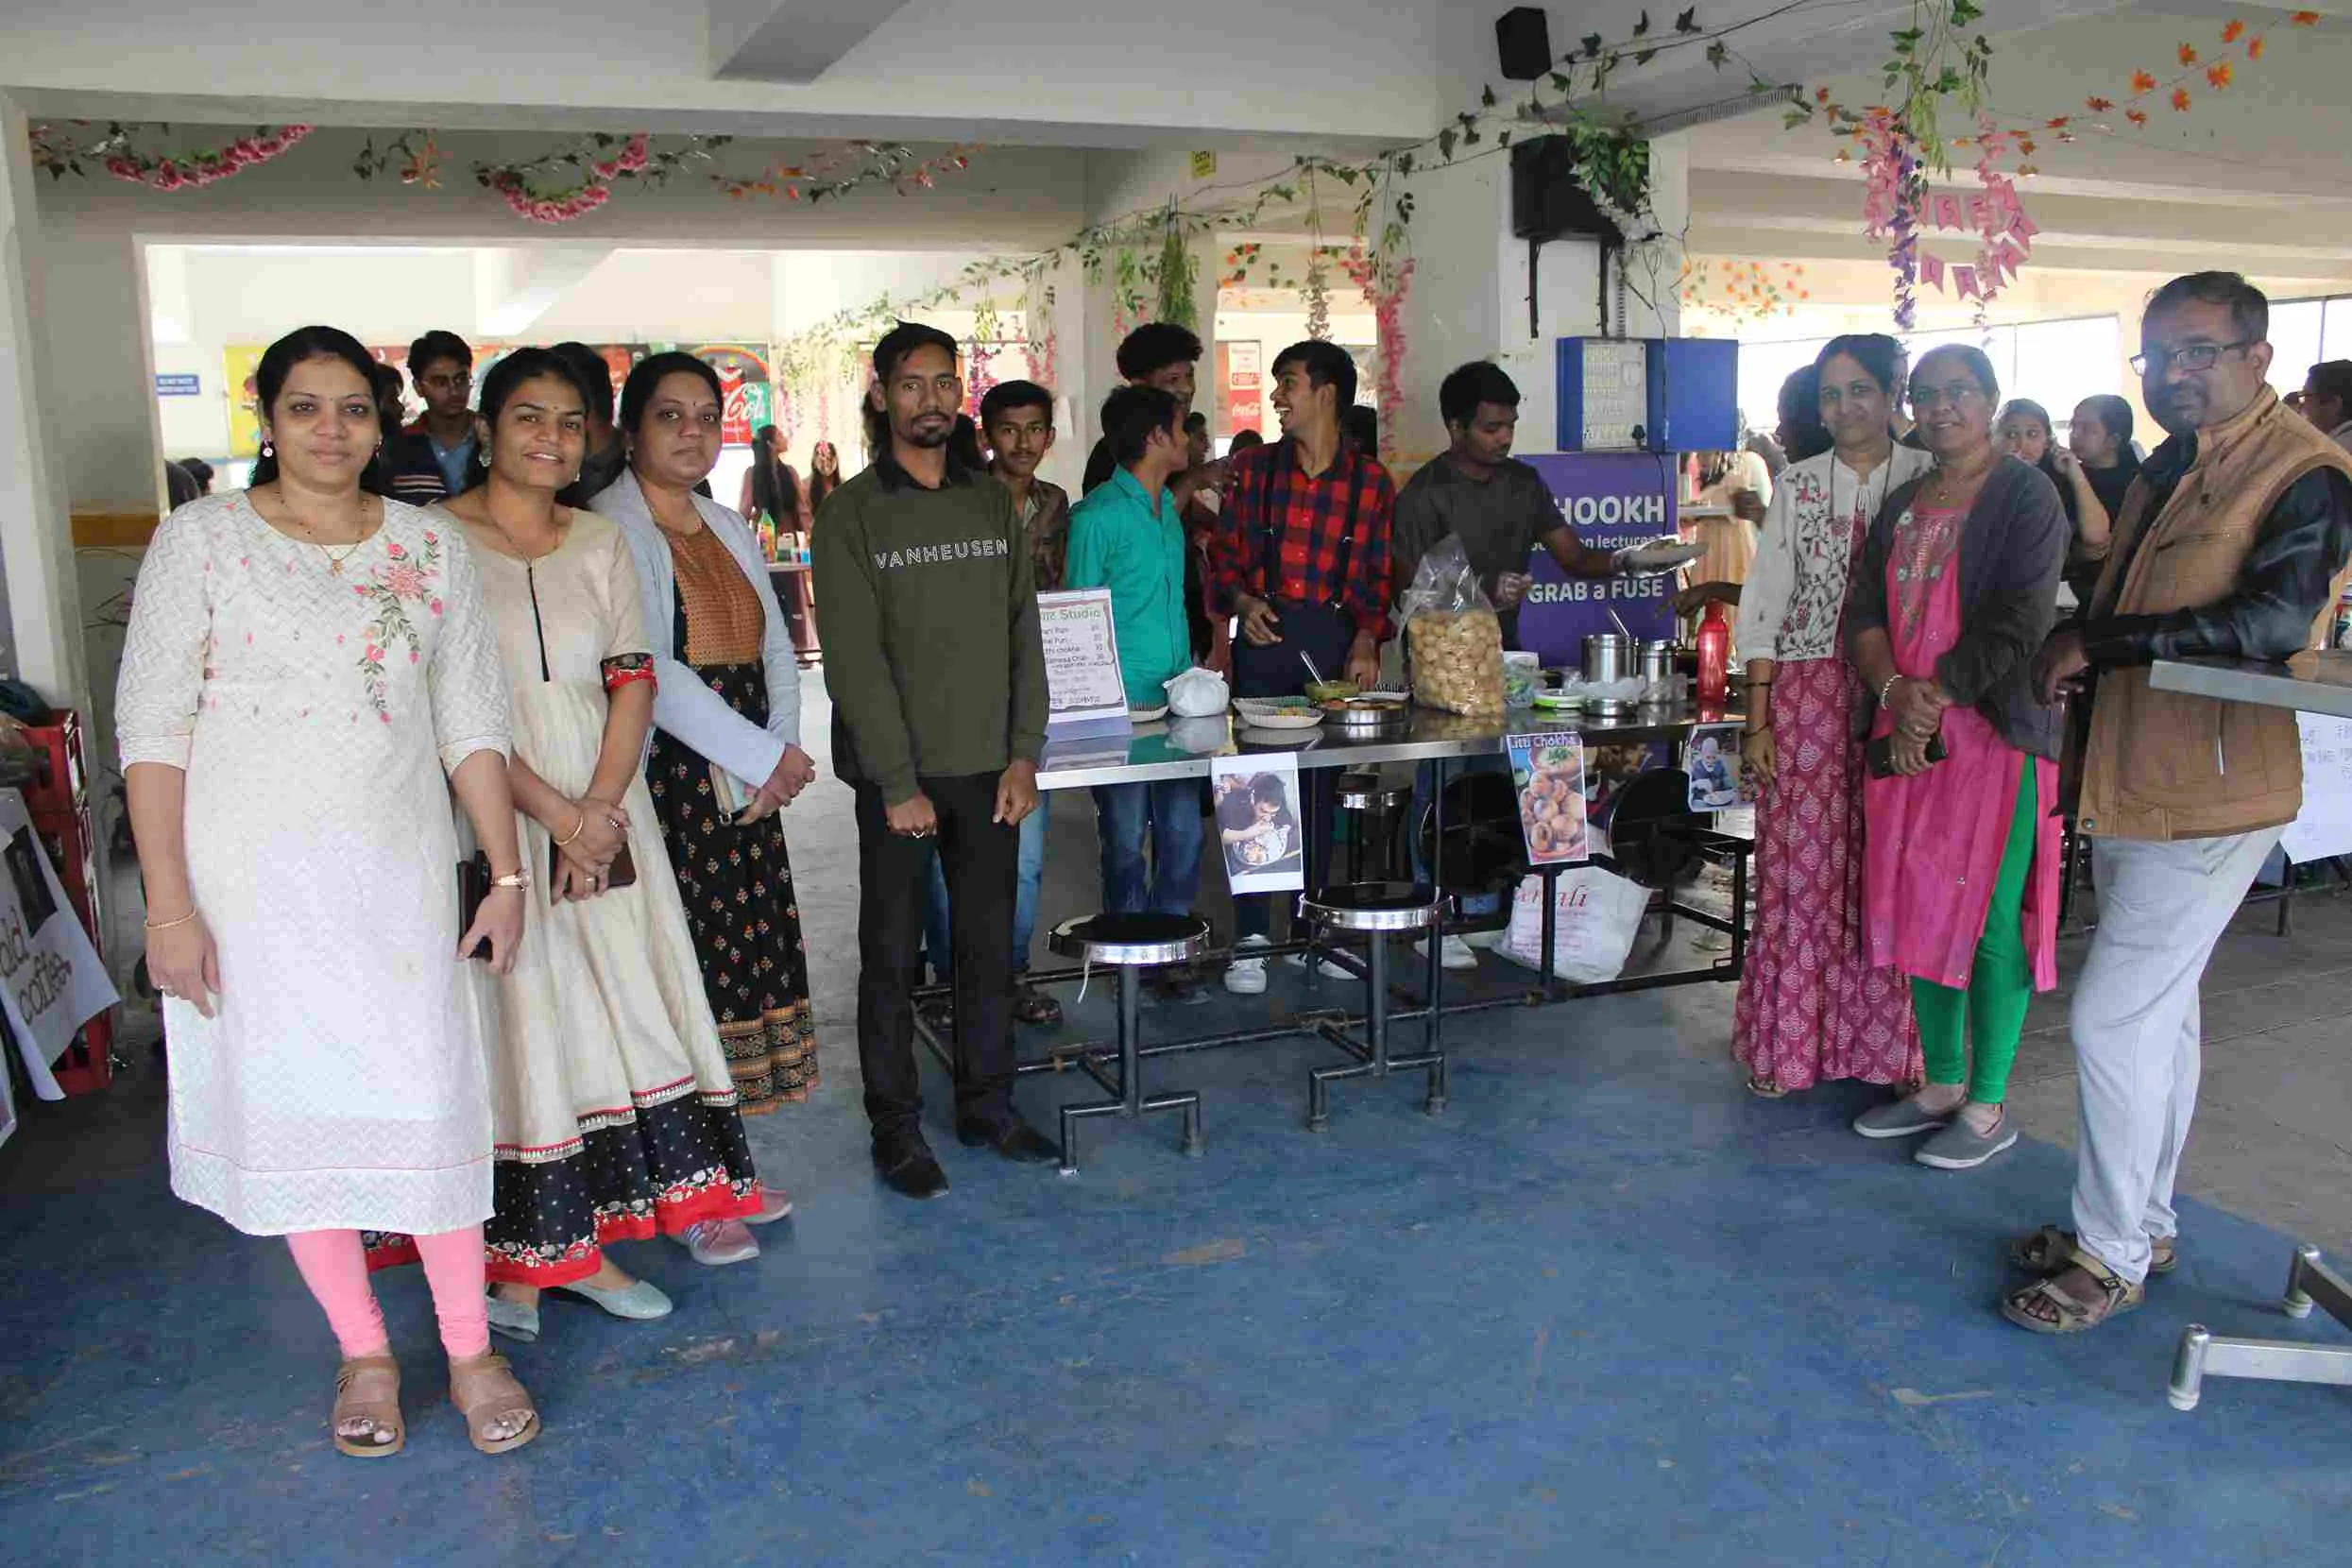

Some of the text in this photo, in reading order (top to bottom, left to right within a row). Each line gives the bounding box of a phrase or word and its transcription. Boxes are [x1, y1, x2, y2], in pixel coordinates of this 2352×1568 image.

[874, 537, 1009, 569] VANHEUSEN
[1527, 578, 1663, 604] GRAB a FUSE
